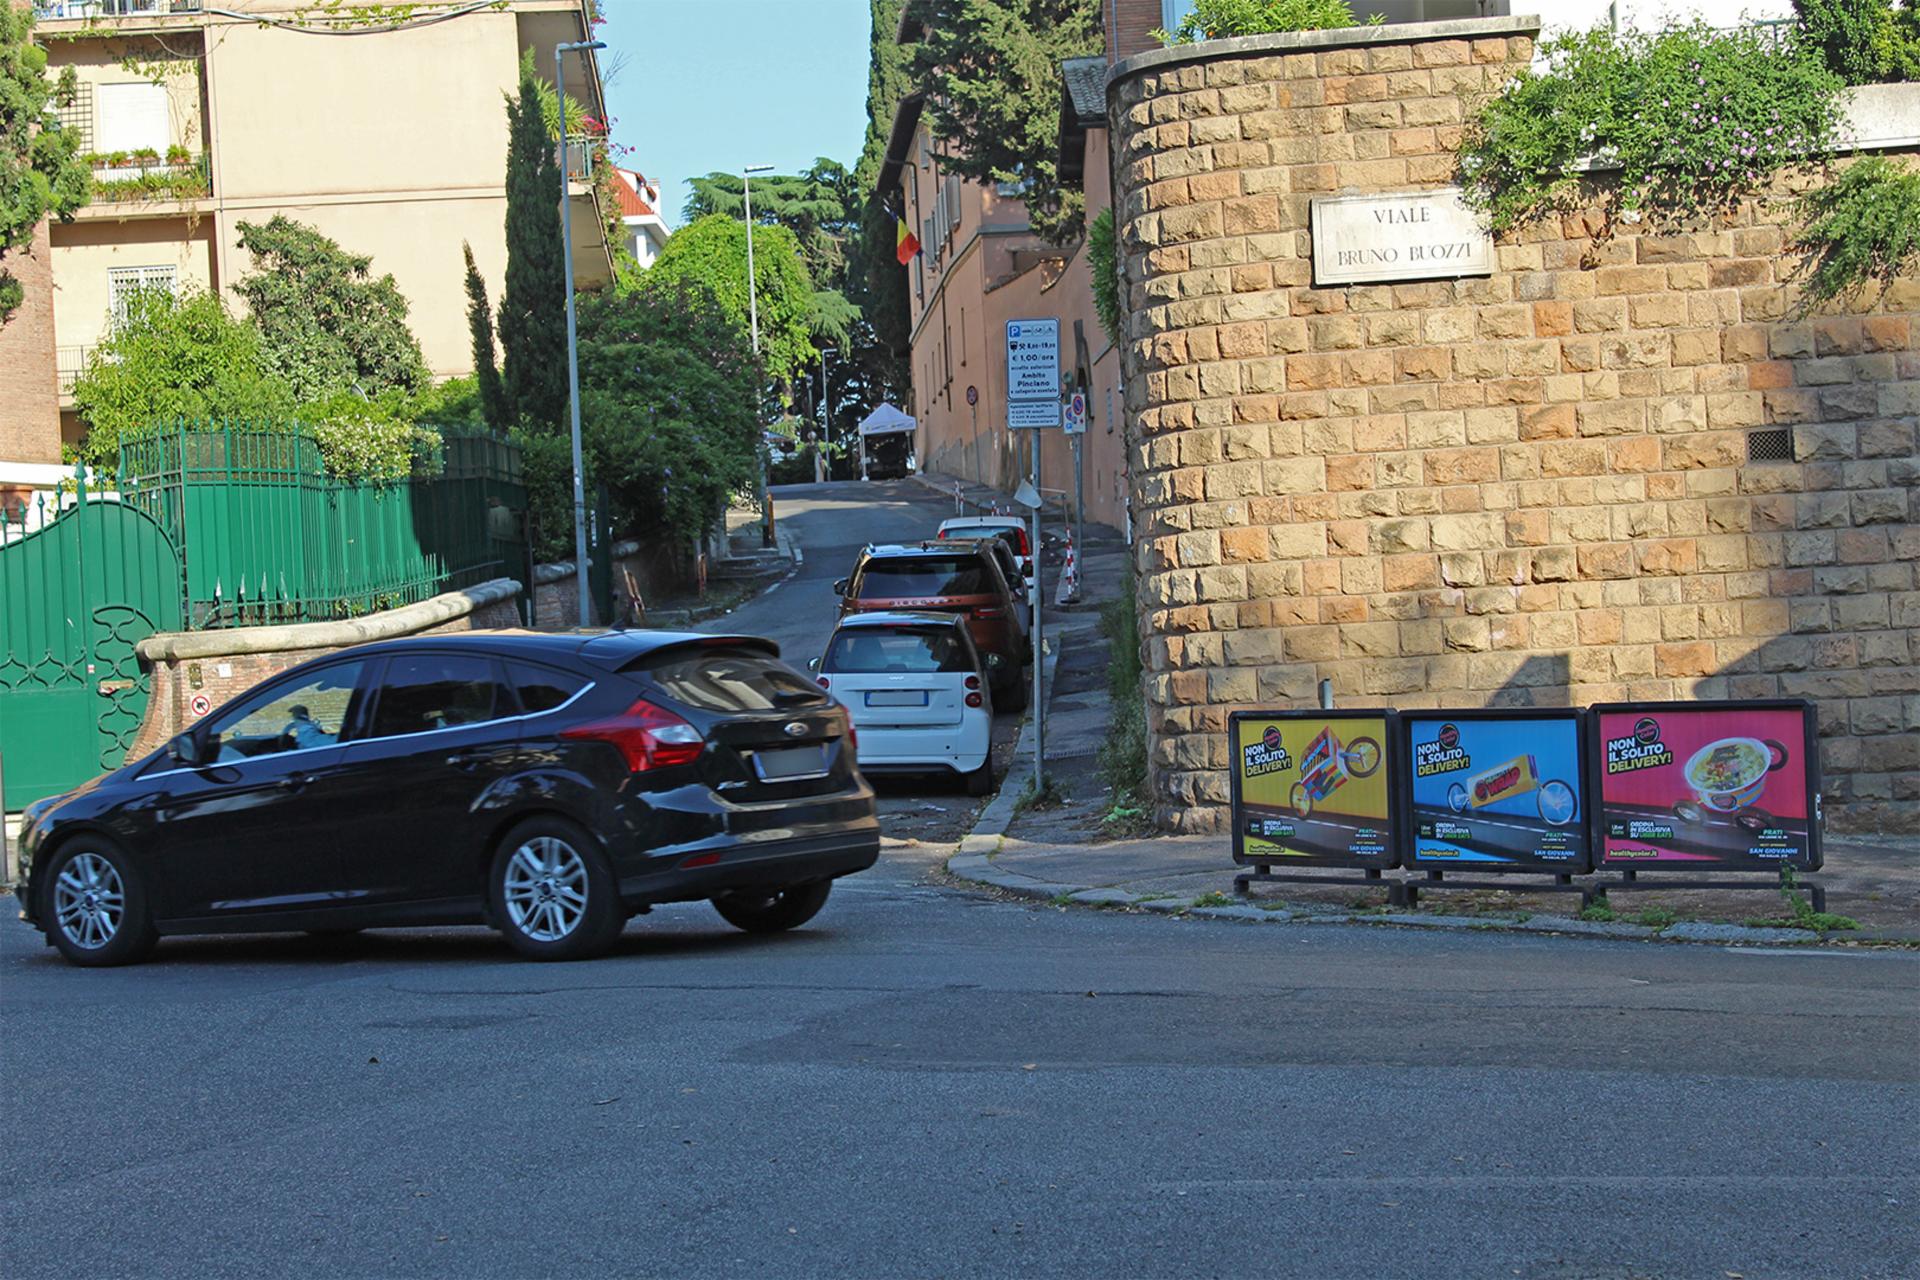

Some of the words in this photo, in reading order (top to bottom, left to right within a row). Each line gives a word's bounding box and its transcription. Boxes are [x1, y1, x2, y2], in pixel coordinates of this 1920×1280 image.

[1373, 207, 1431, 225] VIALE
[1338, 248, 1399, 267] BRUNO
[1409, 242, 1472, 262] BUOZZI
[1245, 743, 1265, 757] NON
[1417, 742, 1440, 755] NON
[1608, 737, 1635, 751] NON
[1608, 752, 1619, 762] IL
[1620, 743, 1664, 760] SOLITO
[1246, 757, 1254, 767] IL
[1254, 749, 1286, 765] SOLITO
[1418, 755, 1427, 766] IL
[1427, 748, 1463, 764] SOLITO
[1609, 752, 1671, 773] DELIVERY!
[1246, 757, 1291, 776] DELIVERY!
[1418, 757, 1469, 776] DELIVERY!
